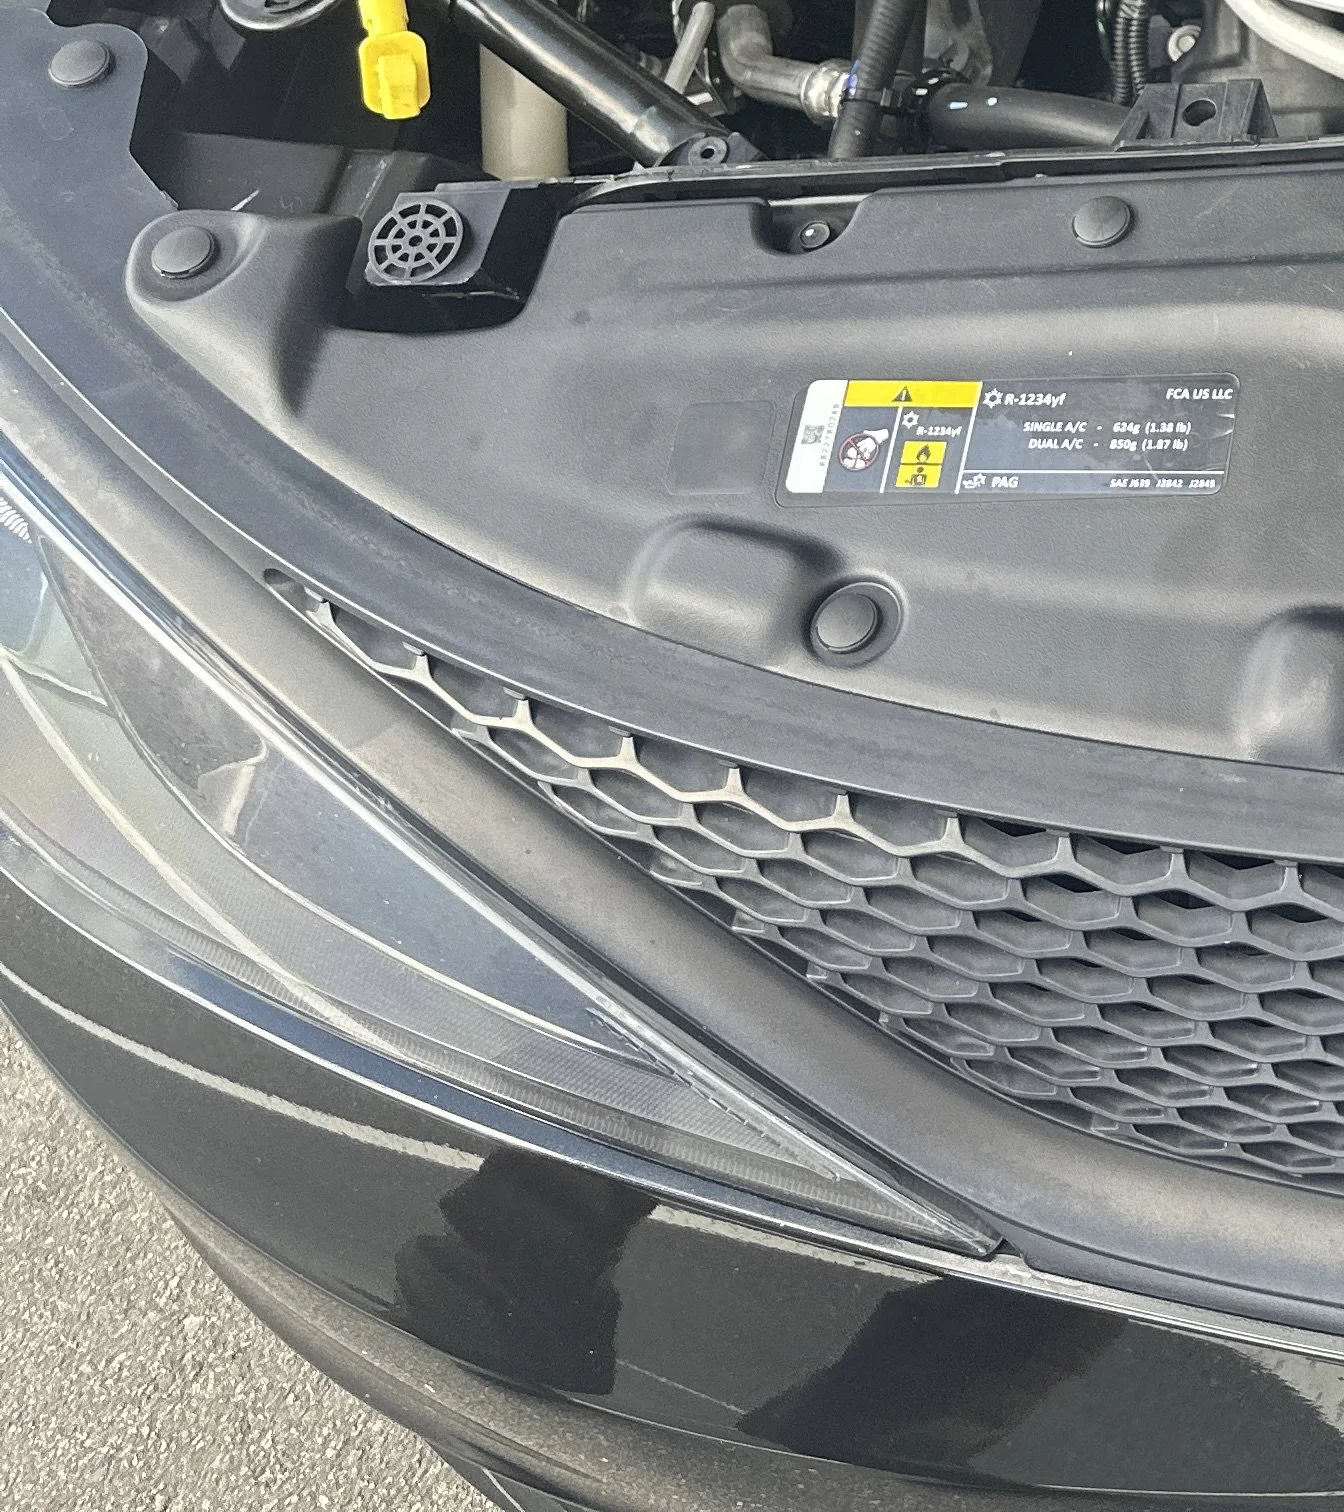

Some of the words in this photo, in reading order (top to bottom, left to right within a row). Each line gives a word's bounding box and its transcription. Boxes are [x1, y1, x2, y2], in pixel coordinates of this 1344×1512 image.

[1004, 392, 1067, 408] R-1234yf
[1166, 388, 1189, 400] FCA
[1192, 388, 1209, 400] US
[1211, 388, 1234, 400] LLC
[916, 426, 963, 438] R-1234yf
[1023, 421, 1063, 432] SINGLE
[1064, 421, 1087, 433] A/C
[1113, 422, 1141, 435] 624g
[1176, 421, 1192, 435] lb)
[1028, 438, 1059, 449] DUAL
[1060, 438, 1083, 450] A/C
[1172, 438, 1189, 451] lb)
[991, 476, 1019, 488] PAG
[1110, 478, 1128, 488] SAE
